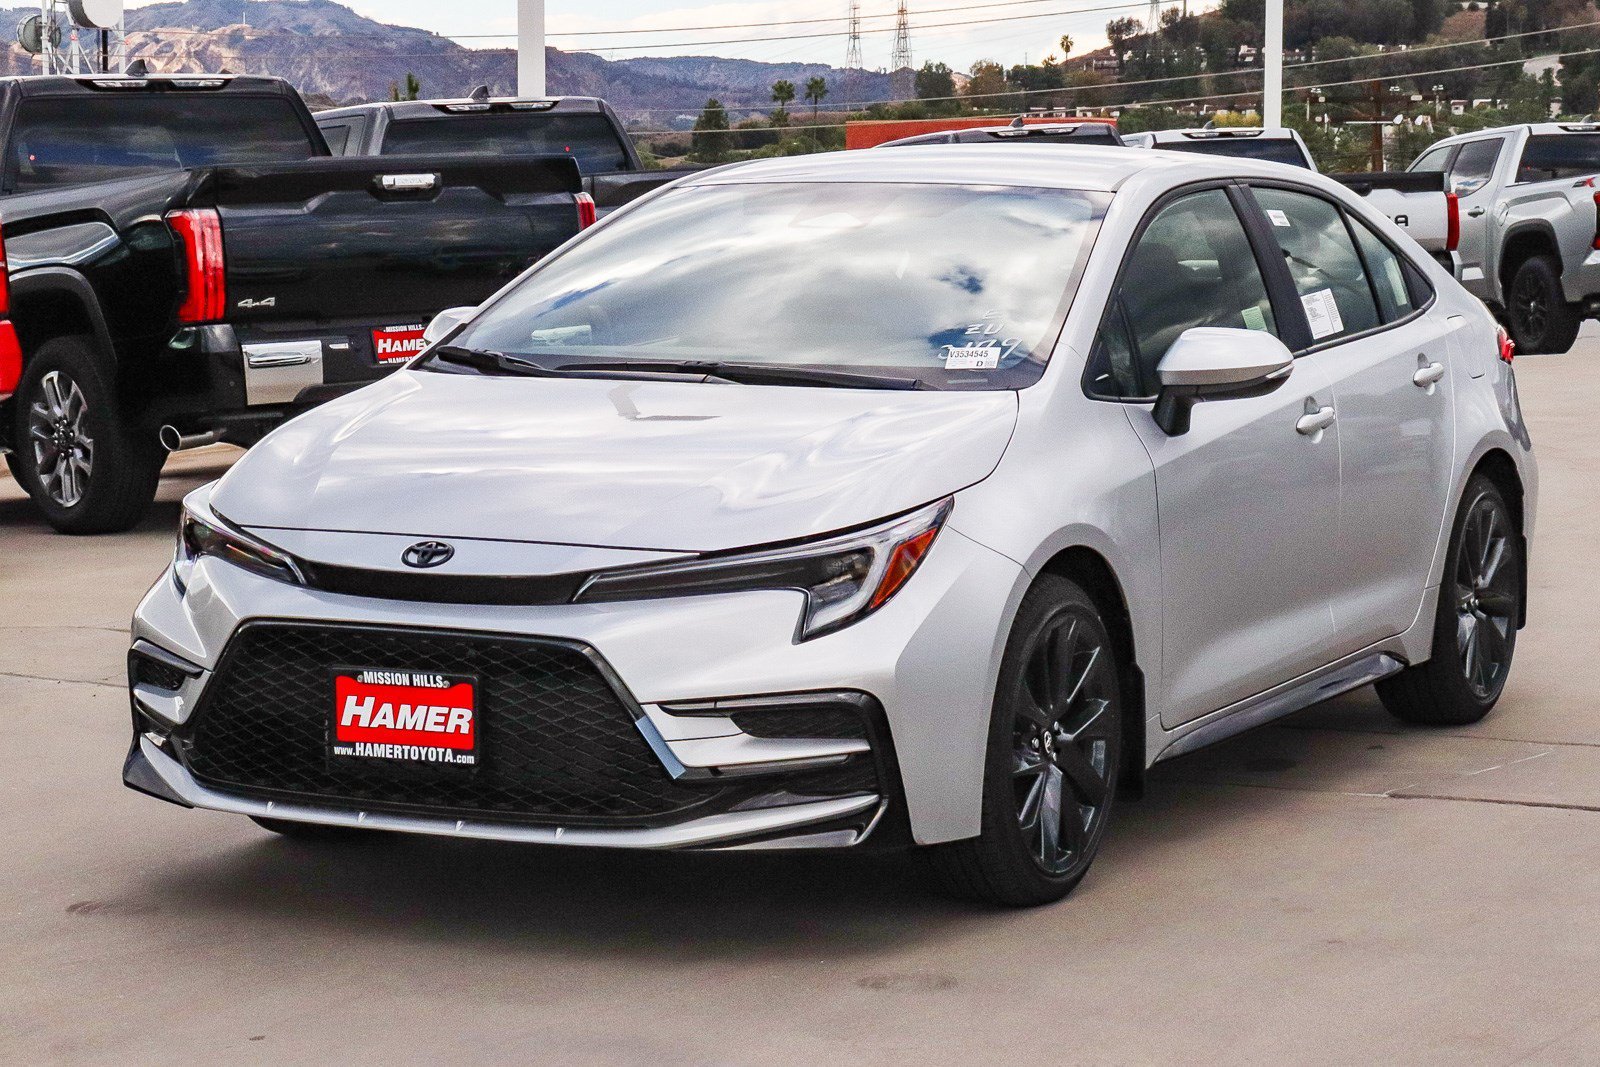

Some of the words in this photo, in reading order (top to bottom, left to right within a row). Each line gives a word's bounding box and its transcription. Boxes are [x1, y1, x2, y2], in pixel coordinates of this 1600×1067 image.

[377, 338, 426, 354] HAME
[949, 350, 989, 358] V3534545
[363, 671, 410, 686] MISSION
[413, 674, 443, 688] HILLS
[340, 695, 473, 734] HAMER
[333, 742, 475, 765] www.HAMERTOYOTA.com
